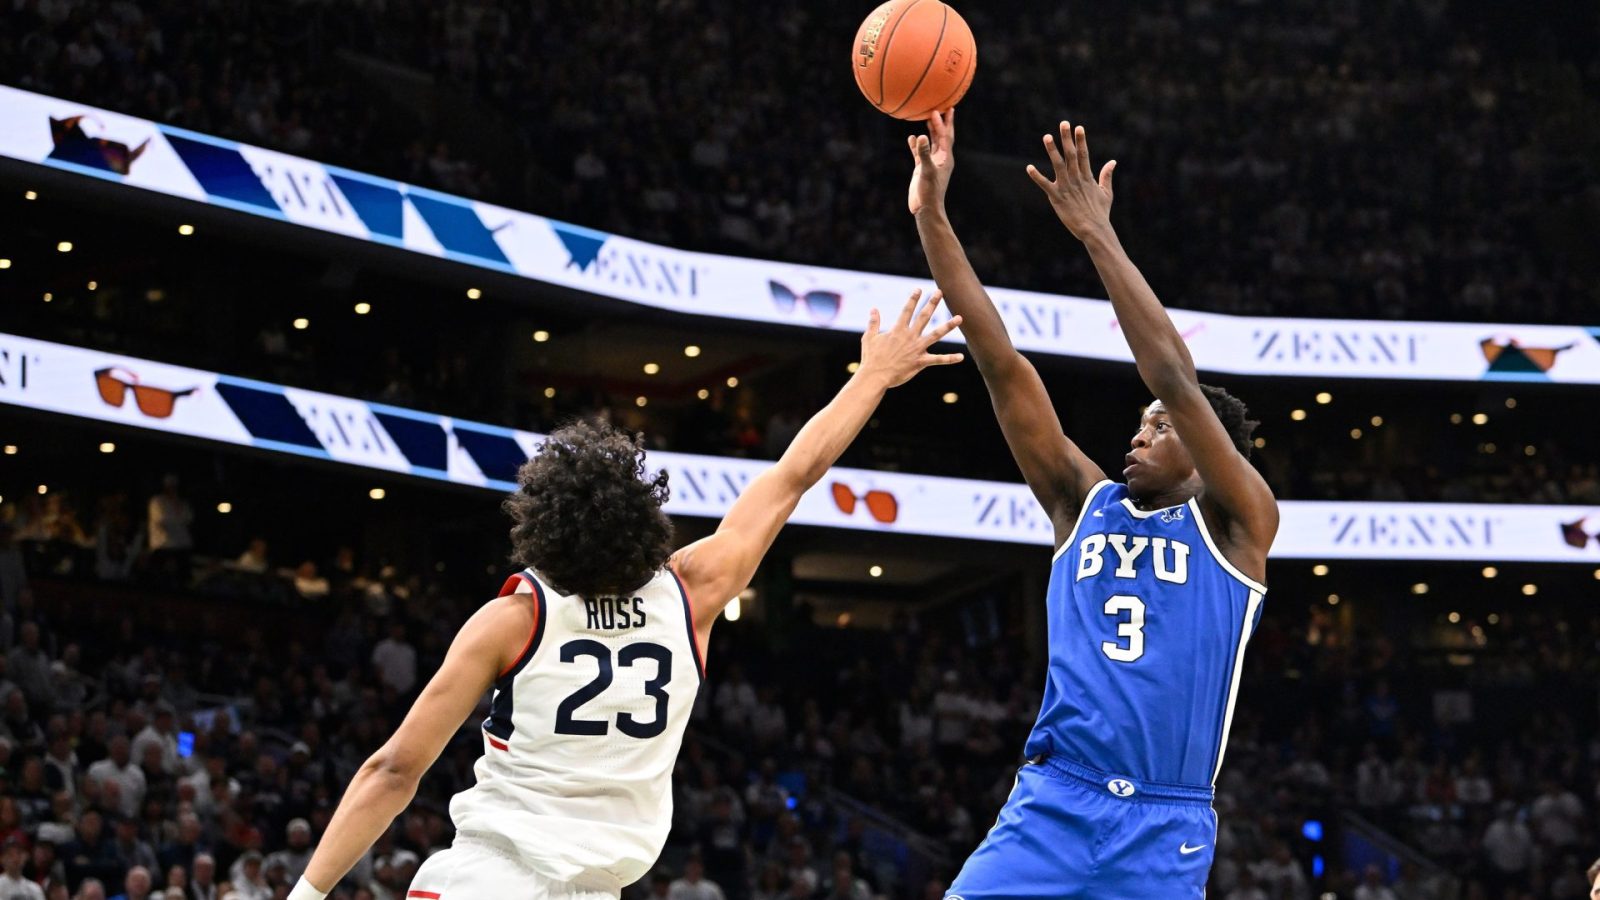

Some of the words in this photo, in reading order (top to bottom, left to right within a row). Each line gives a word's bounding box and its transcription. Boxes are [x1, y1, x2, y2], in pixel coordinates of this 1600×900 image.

[566, 248, 697, 297] ENNI
[1253, 330, 1416, 364] ZENNI
[1330, 513, 1491, 546] ZENNI
[1076, 533, 1190, 584] BYU
[585, 597, 646, 629] ROSS
[1102, 595, 1146, 663] 3
[554, 639, 672, 739] 23
